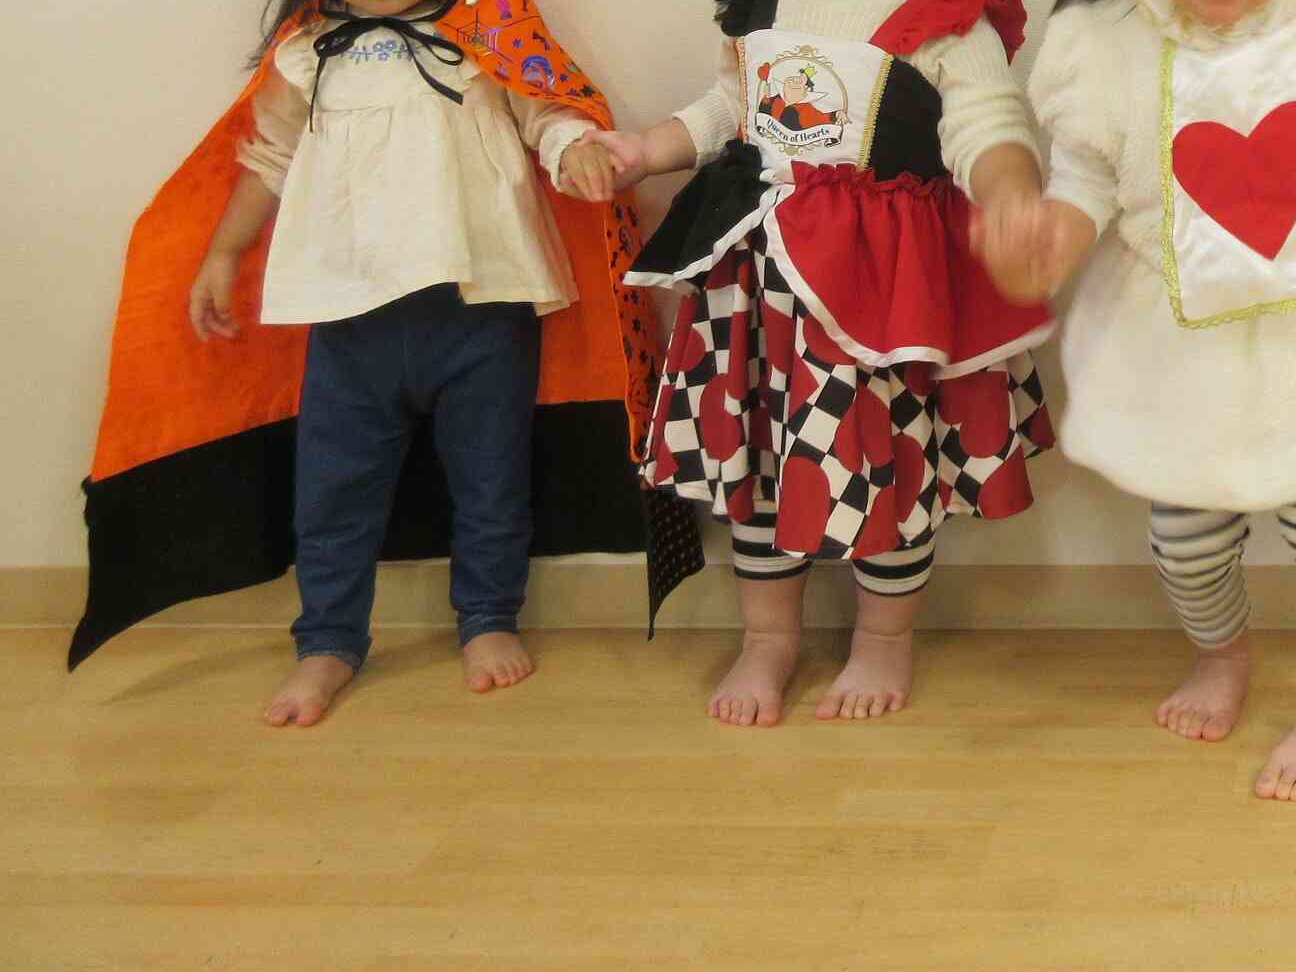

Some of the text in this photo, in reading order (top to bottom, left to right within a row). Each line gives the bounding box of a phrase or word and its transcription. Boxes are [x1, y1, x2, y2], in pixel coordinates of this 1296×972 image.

[766, 118, 830, 143] Queen of Hearts
